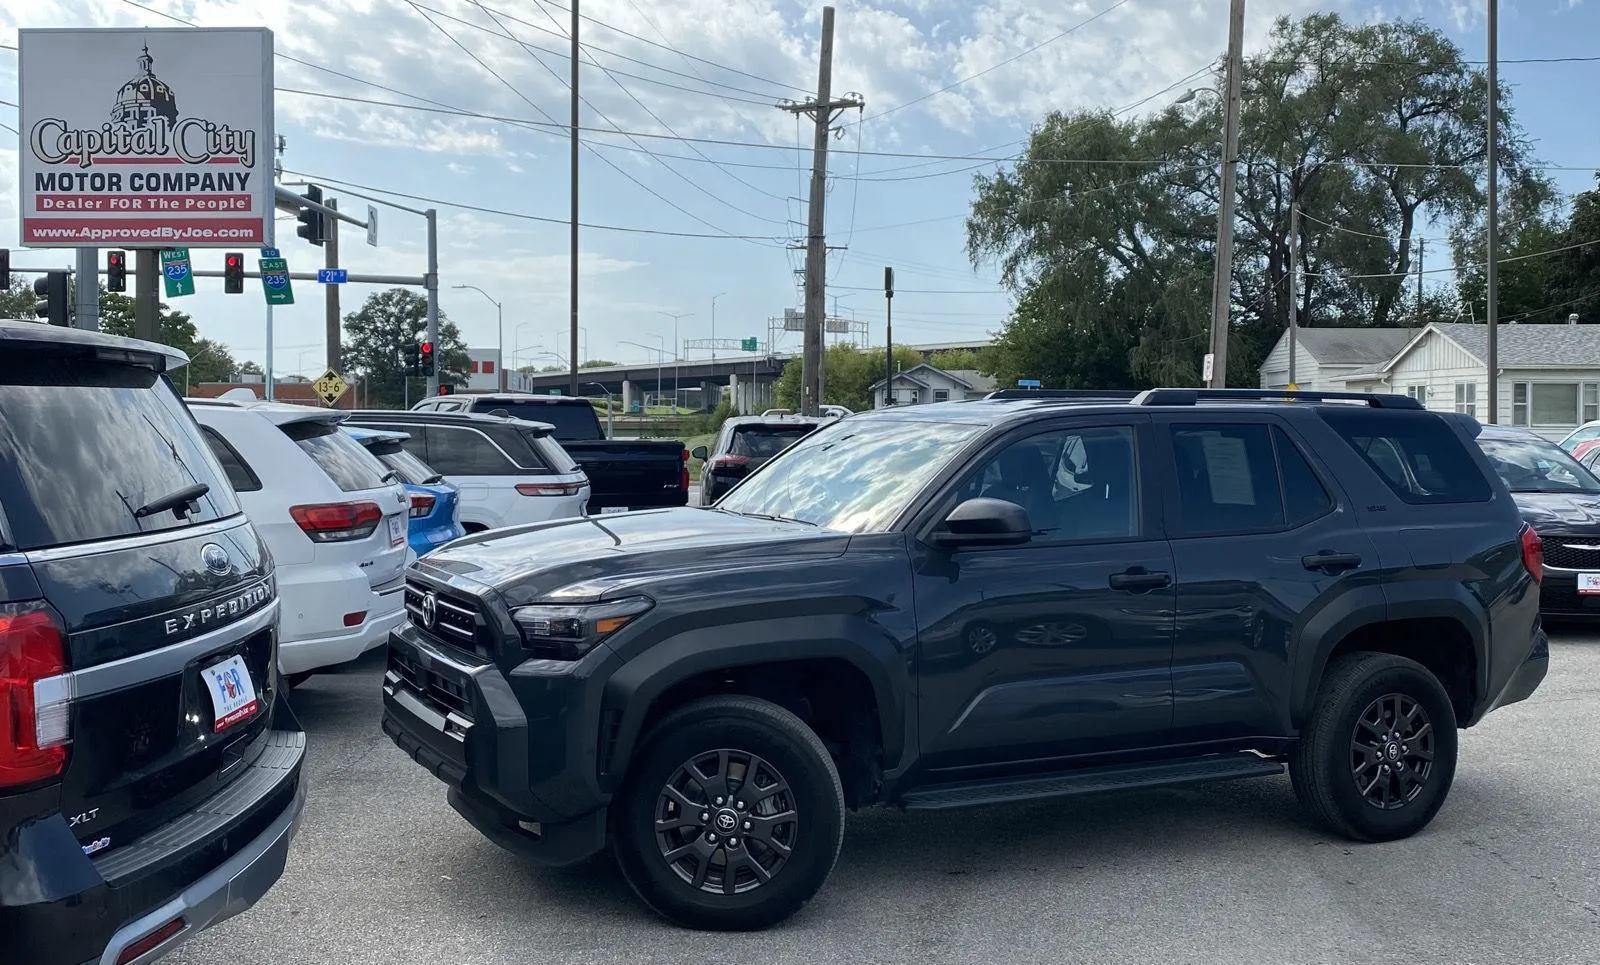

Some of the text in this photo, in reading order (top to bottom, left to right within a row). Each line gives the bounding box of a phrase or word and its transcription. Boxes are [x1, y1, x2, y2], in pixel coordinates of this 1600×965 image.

[30, 117, 255, 168] Capital City
[35, 172, 251, 192] MOTOR COMPANY
[43, 198, 245, 212] Dealer FOR The People
[32, 226, 254, 241] www.ApprovedByJoe.com
[163, 250, 186, 259] WEST
[265, 249, 276, 257] TO
[168, 264, 188, 276] 235
[262, 261, 284, 269] EAST
[266, 275, 286, 285] 235
[164, 583, 271, 635] EXPEDITION
[69, 807, 100, 828] XLT
